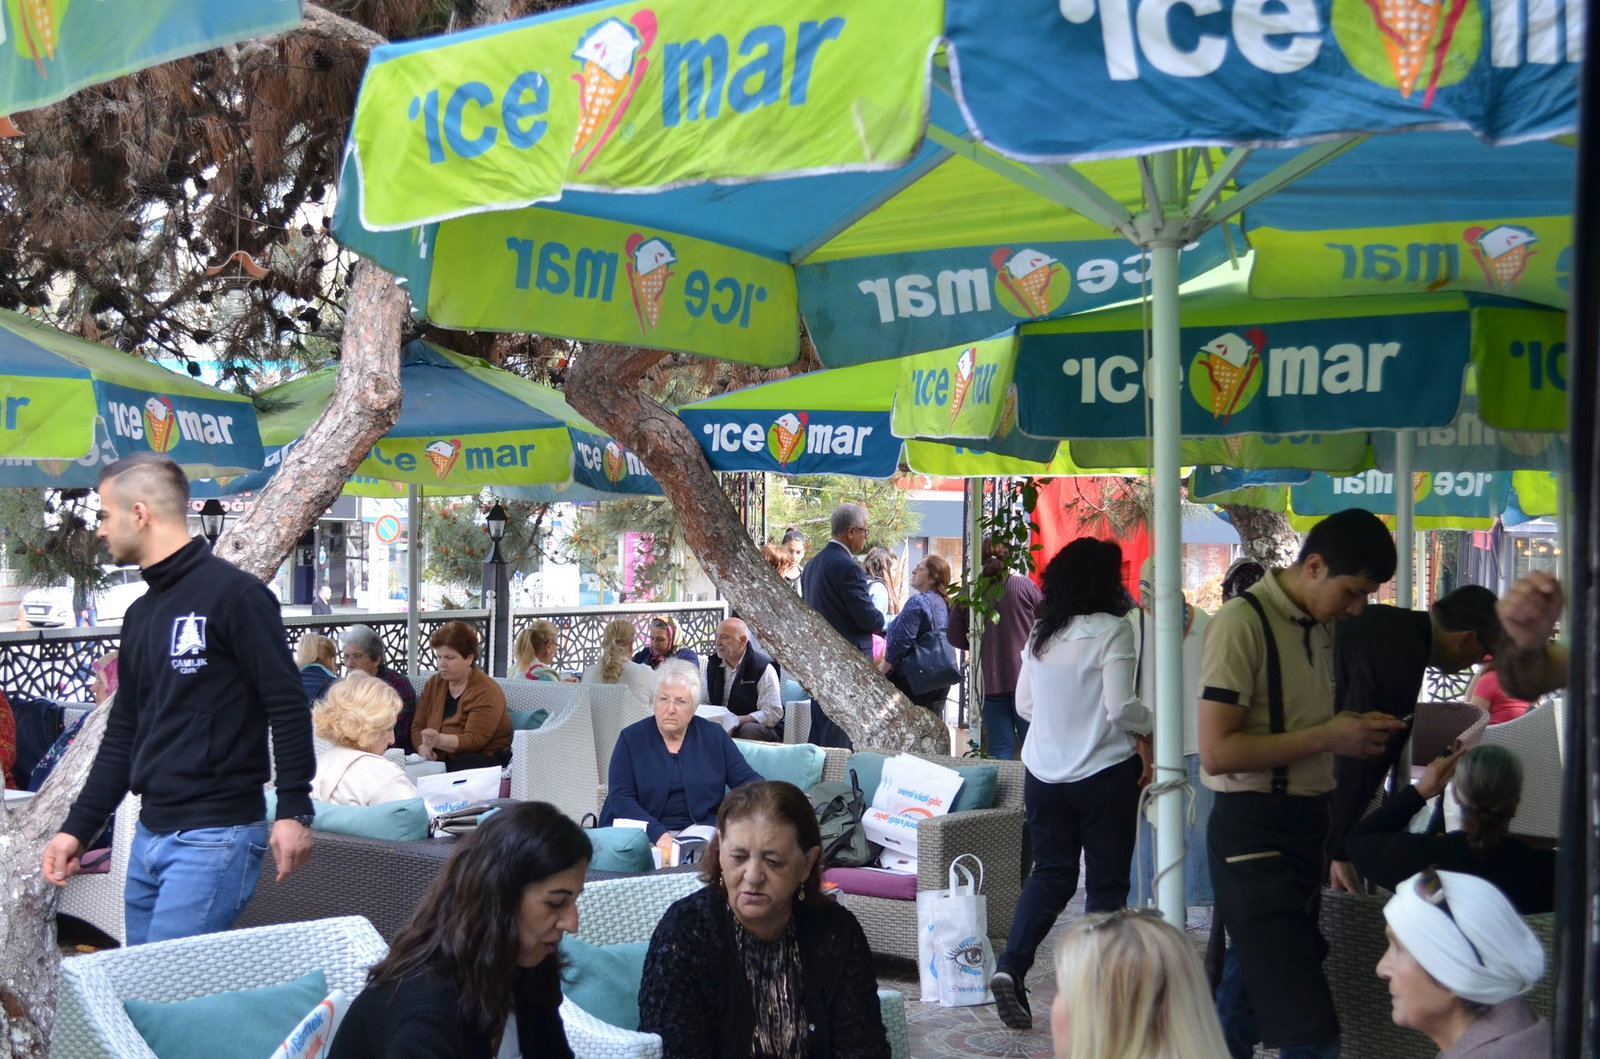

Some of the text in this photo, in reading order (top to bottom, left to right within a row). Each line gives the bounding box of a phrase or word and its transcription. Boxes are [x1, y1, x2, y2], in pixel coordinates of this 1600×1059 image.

[407, 16, 847, 165] ice mar
[911, 368, 950, 407] ice
[1267, 341, 1402, 398] mar
[109, 400, 234, 445] ice mar
[703, 422, 874, 457] ice mar
[465, 442, 536, 471] mar
